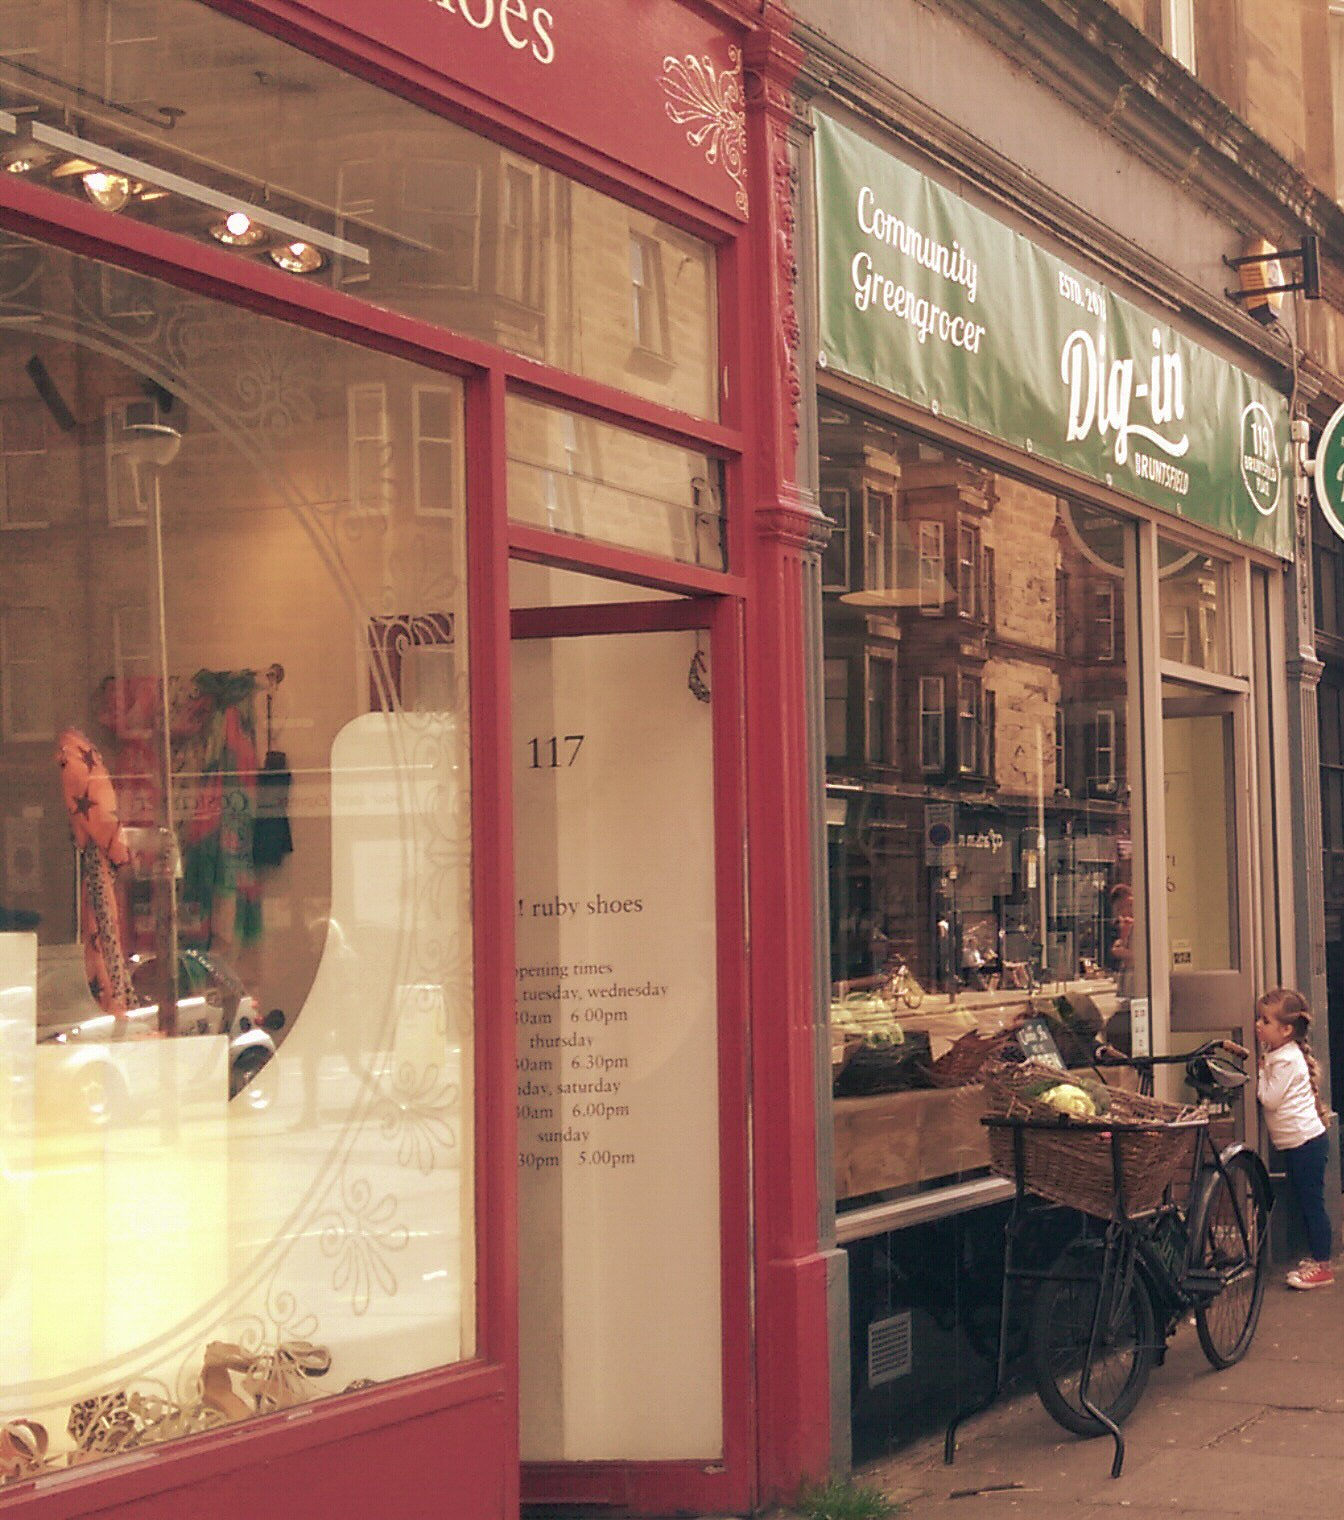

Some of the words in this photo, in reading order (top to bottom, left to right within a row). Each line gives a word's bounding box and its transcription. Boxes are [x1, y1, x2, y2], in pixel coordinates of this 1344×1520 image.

[431, 0, 555, 64] oes
[857, 186, 977, 303] Community
[852, 252, 985, 353] Greengrocer
[1058, 271, 1084, 307] ESTD.
[1061, 327, 1189, 465] Dig-in
[1251, 422, 1269, 460] 119
[1135, 451, 1189, 495] BRUNTSFIELD
[527, 734, 584, 768] 117
[532, 896, 579, 920] ruby
[587, 894, 643, 914] shoes
[573, 964, 614, 976] times
[523, 985, 583, 1001] tuesday,
[588, 982, 668, 998] wednesday
[530, 1032, 593, 1049] thursday
[557, 1077, 620, 1094] saturday
[572, 1103, 629, 1120] 6.00pm
[537, 1126, 590, 1142] sunday
[579, 1150, 635, 1168] 5.00pm
